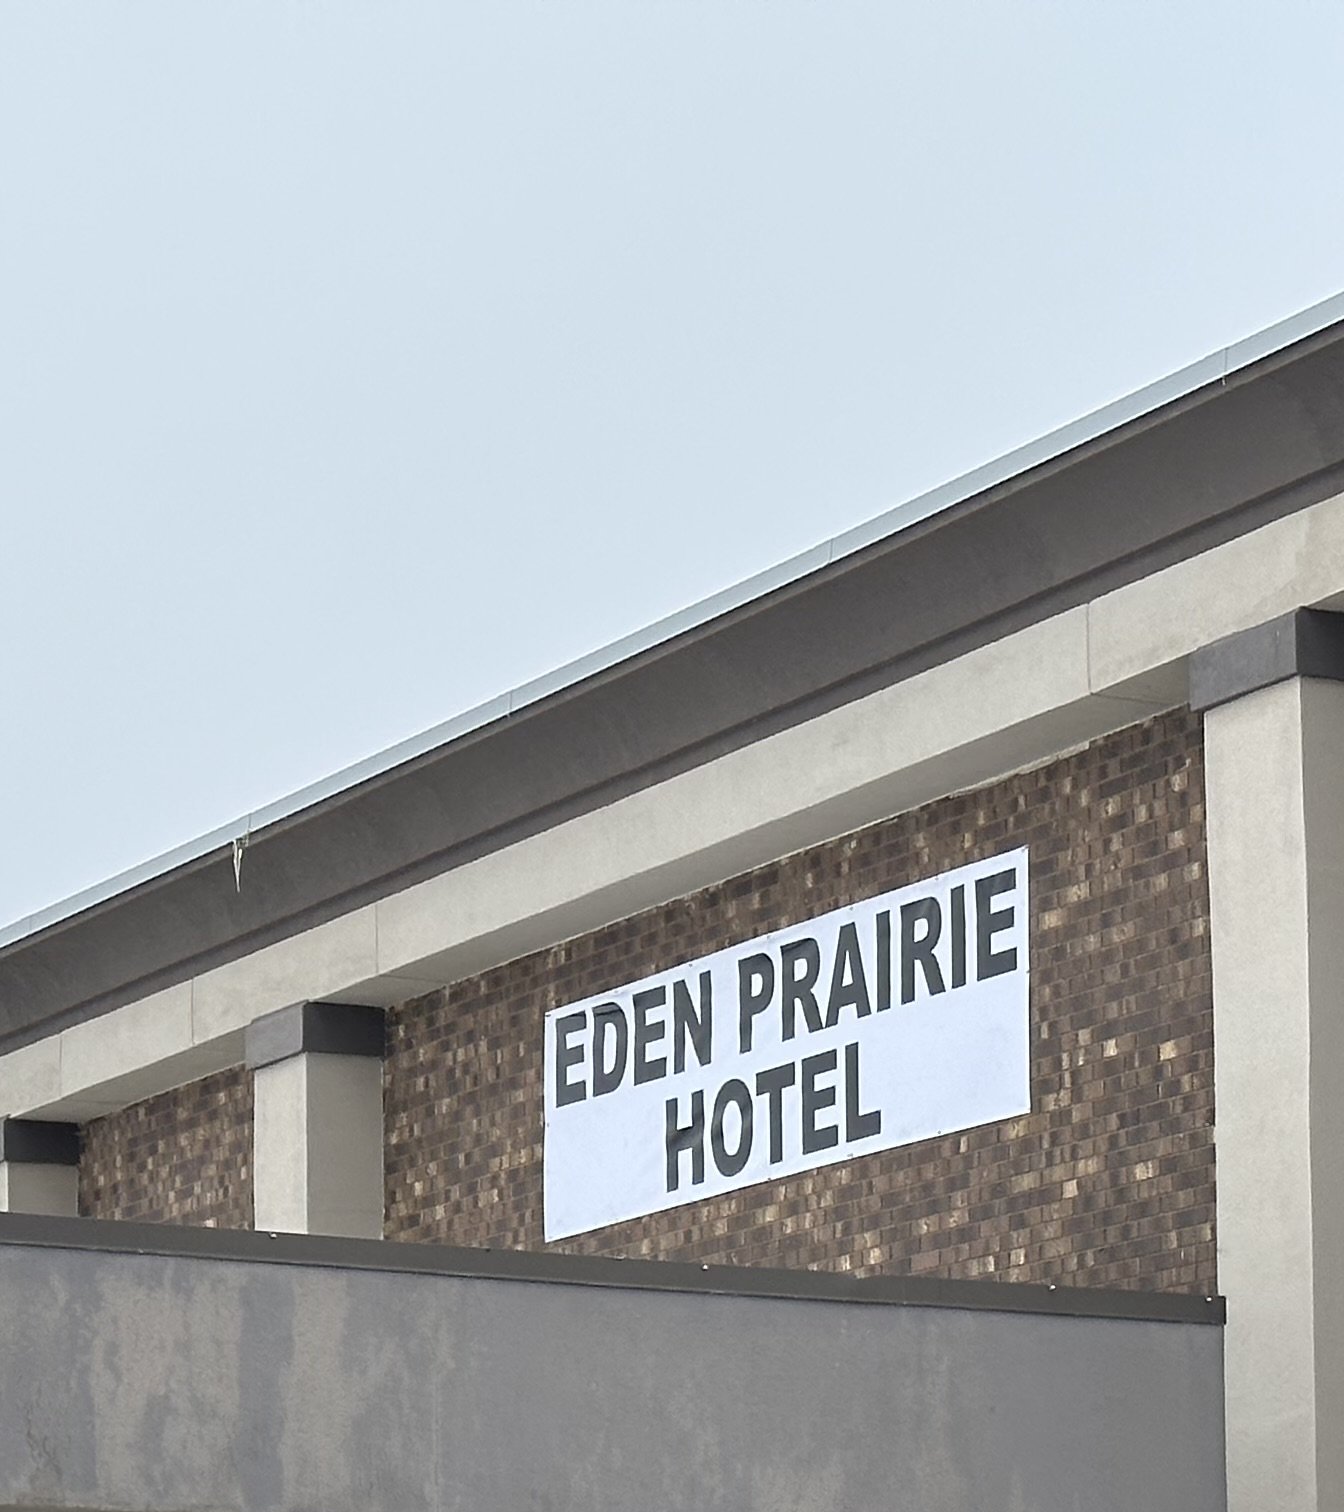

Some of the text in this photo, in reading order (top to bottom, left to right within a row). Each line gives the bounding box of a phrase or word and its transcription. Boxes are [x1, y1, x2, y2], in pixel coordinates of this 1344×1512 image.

[555, 868, 1017, 1107] EDEN PRAIRIE
[665, 1041, 882, 1192] HOTEL
